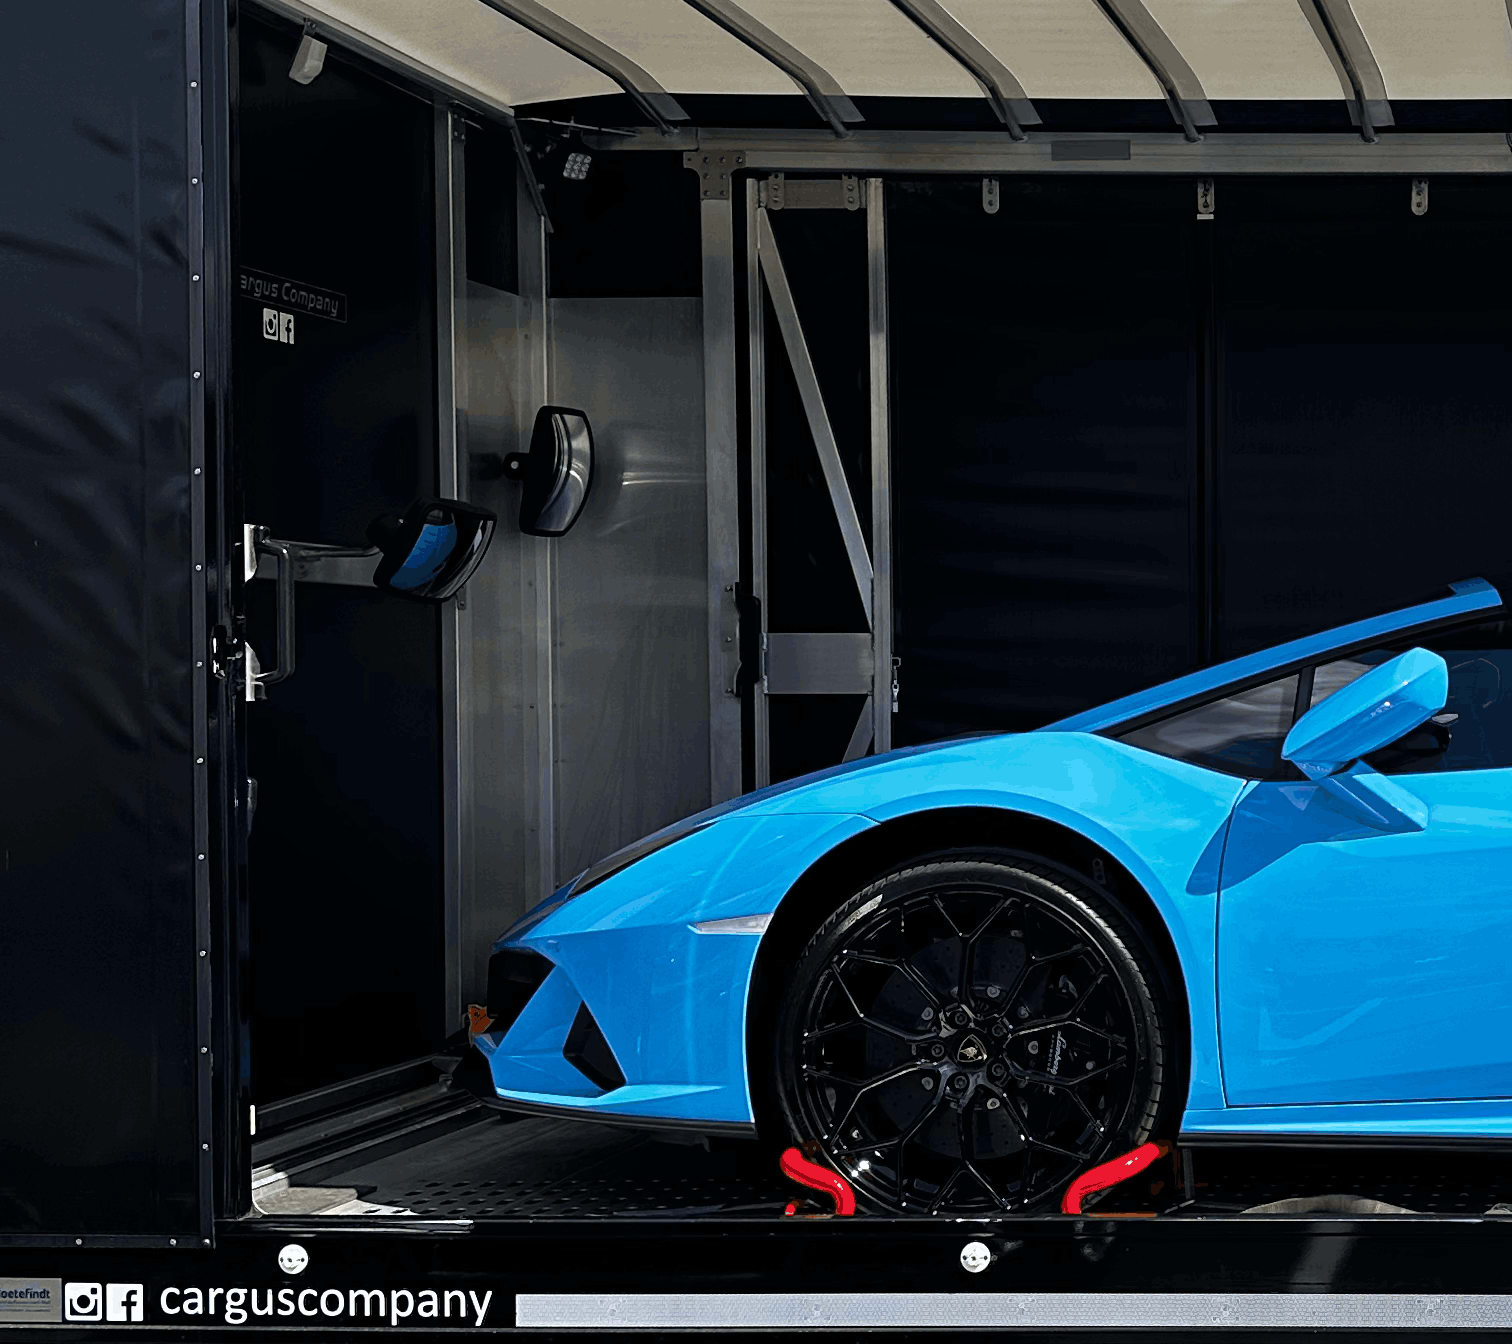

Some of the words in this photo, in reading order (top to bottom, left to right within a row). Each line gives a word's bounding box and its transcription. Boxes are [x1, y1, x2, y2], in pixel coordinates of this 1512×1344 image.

[240, 274, 279, 297] argus
[281, 282, 339, 317] Company
[0, 1288, 50, 1298] oetefindt
[159, 1285, 493, 1326] carguscompany
